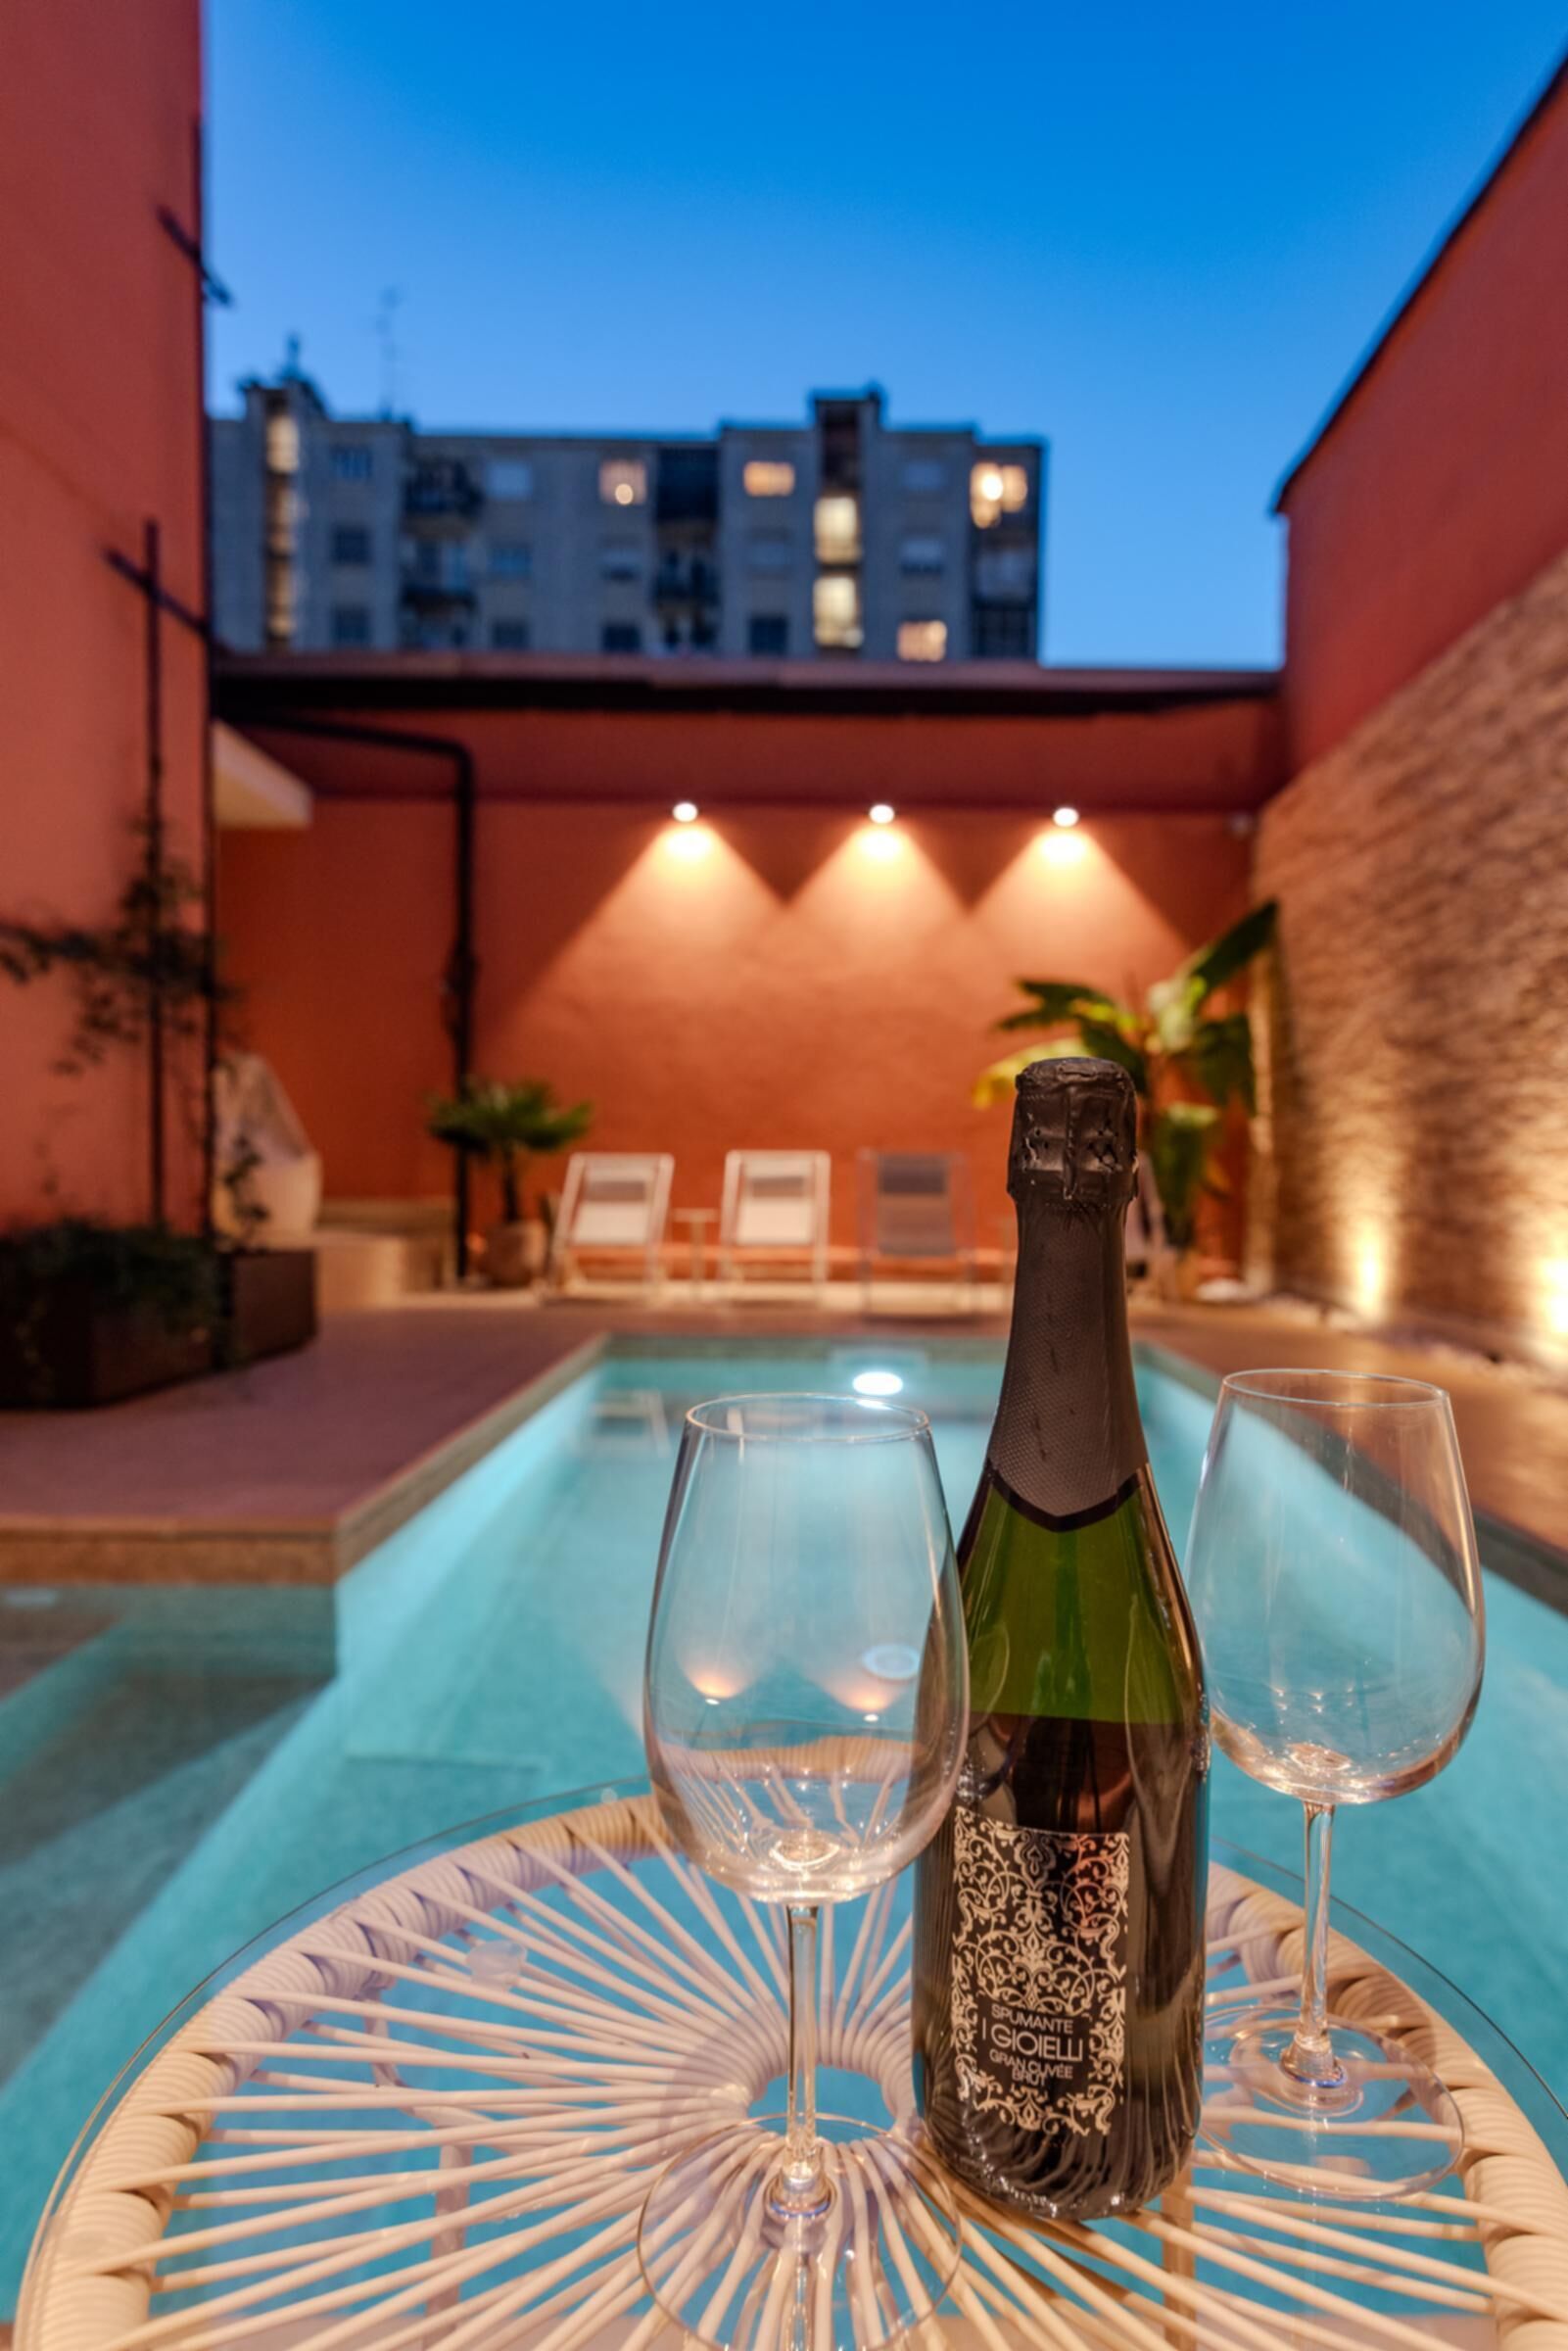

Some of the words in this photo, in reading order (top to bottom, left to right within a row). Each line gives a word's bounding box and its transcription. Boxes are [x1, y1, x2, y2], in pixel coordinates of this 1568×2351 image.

[991, 2003, 1073, 2034] SPUMANTE
[981, 2017, 987, 2040] I
[991, 2024, 1083, 2062] GIOIELLI
[989, 2049, 1025, 2069] GRAN
[1028, 2060, 1073, 2079] CUVÉE
[1012, 2067, 1046, 2086] BRUT
